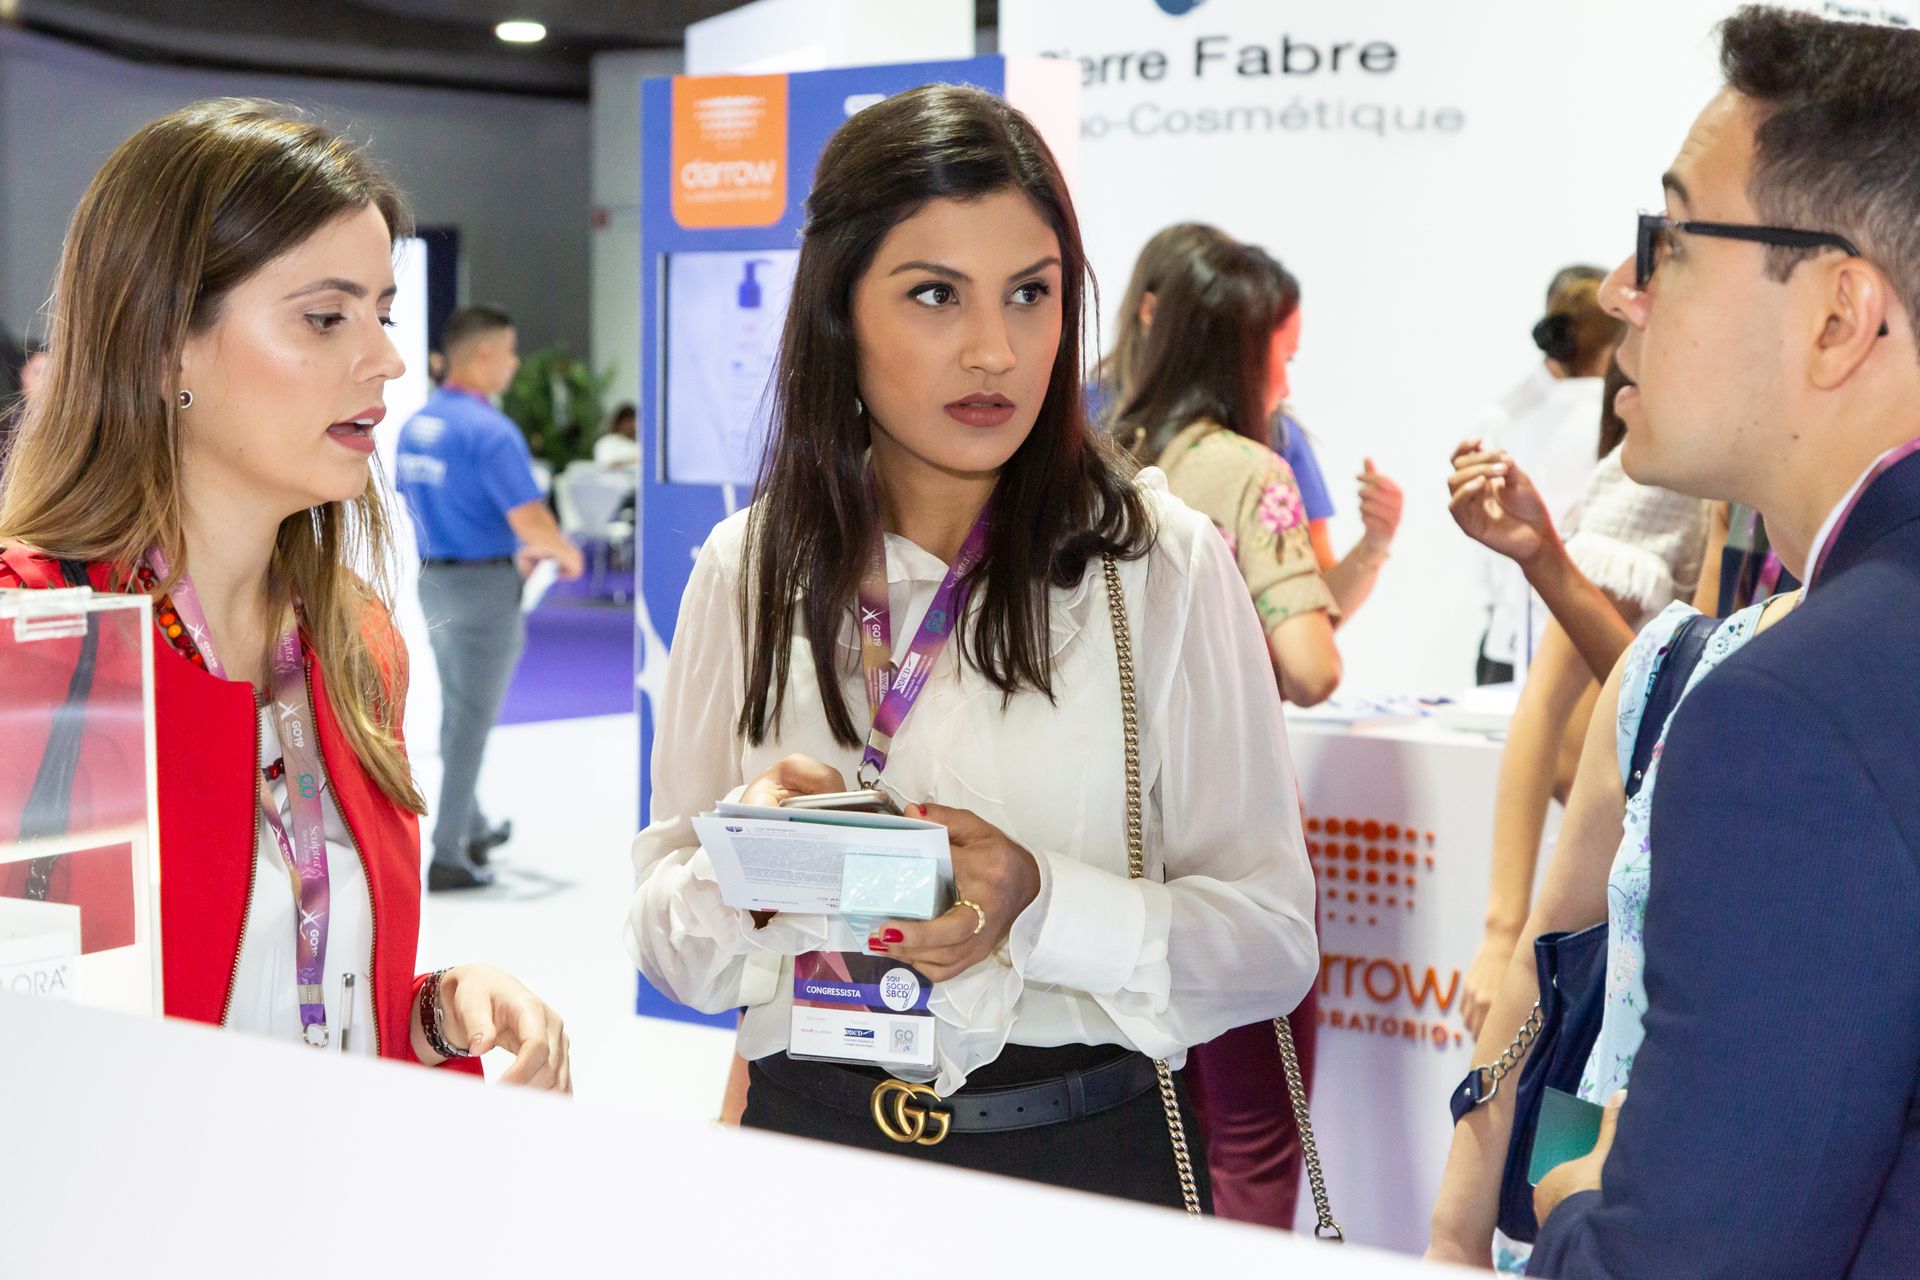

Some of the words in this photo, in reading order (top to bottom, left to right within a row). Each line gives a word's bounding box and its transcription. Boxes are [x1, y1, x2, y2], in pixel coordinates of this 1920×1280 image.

[1039, 49, 1168, 87] erre
[1194, 35, 1398, 77] Fabre
[1079, 96, 1466, 137] o-Cosmétique
[872, 624, 882, 647] GO19
[292, 720, 304, 748] GO19
[806, 985, 861, 998] CONGRESSISTA
[886, 990, 908, 999] SBCD
[1321, 955, 1461, 1013] rrow
